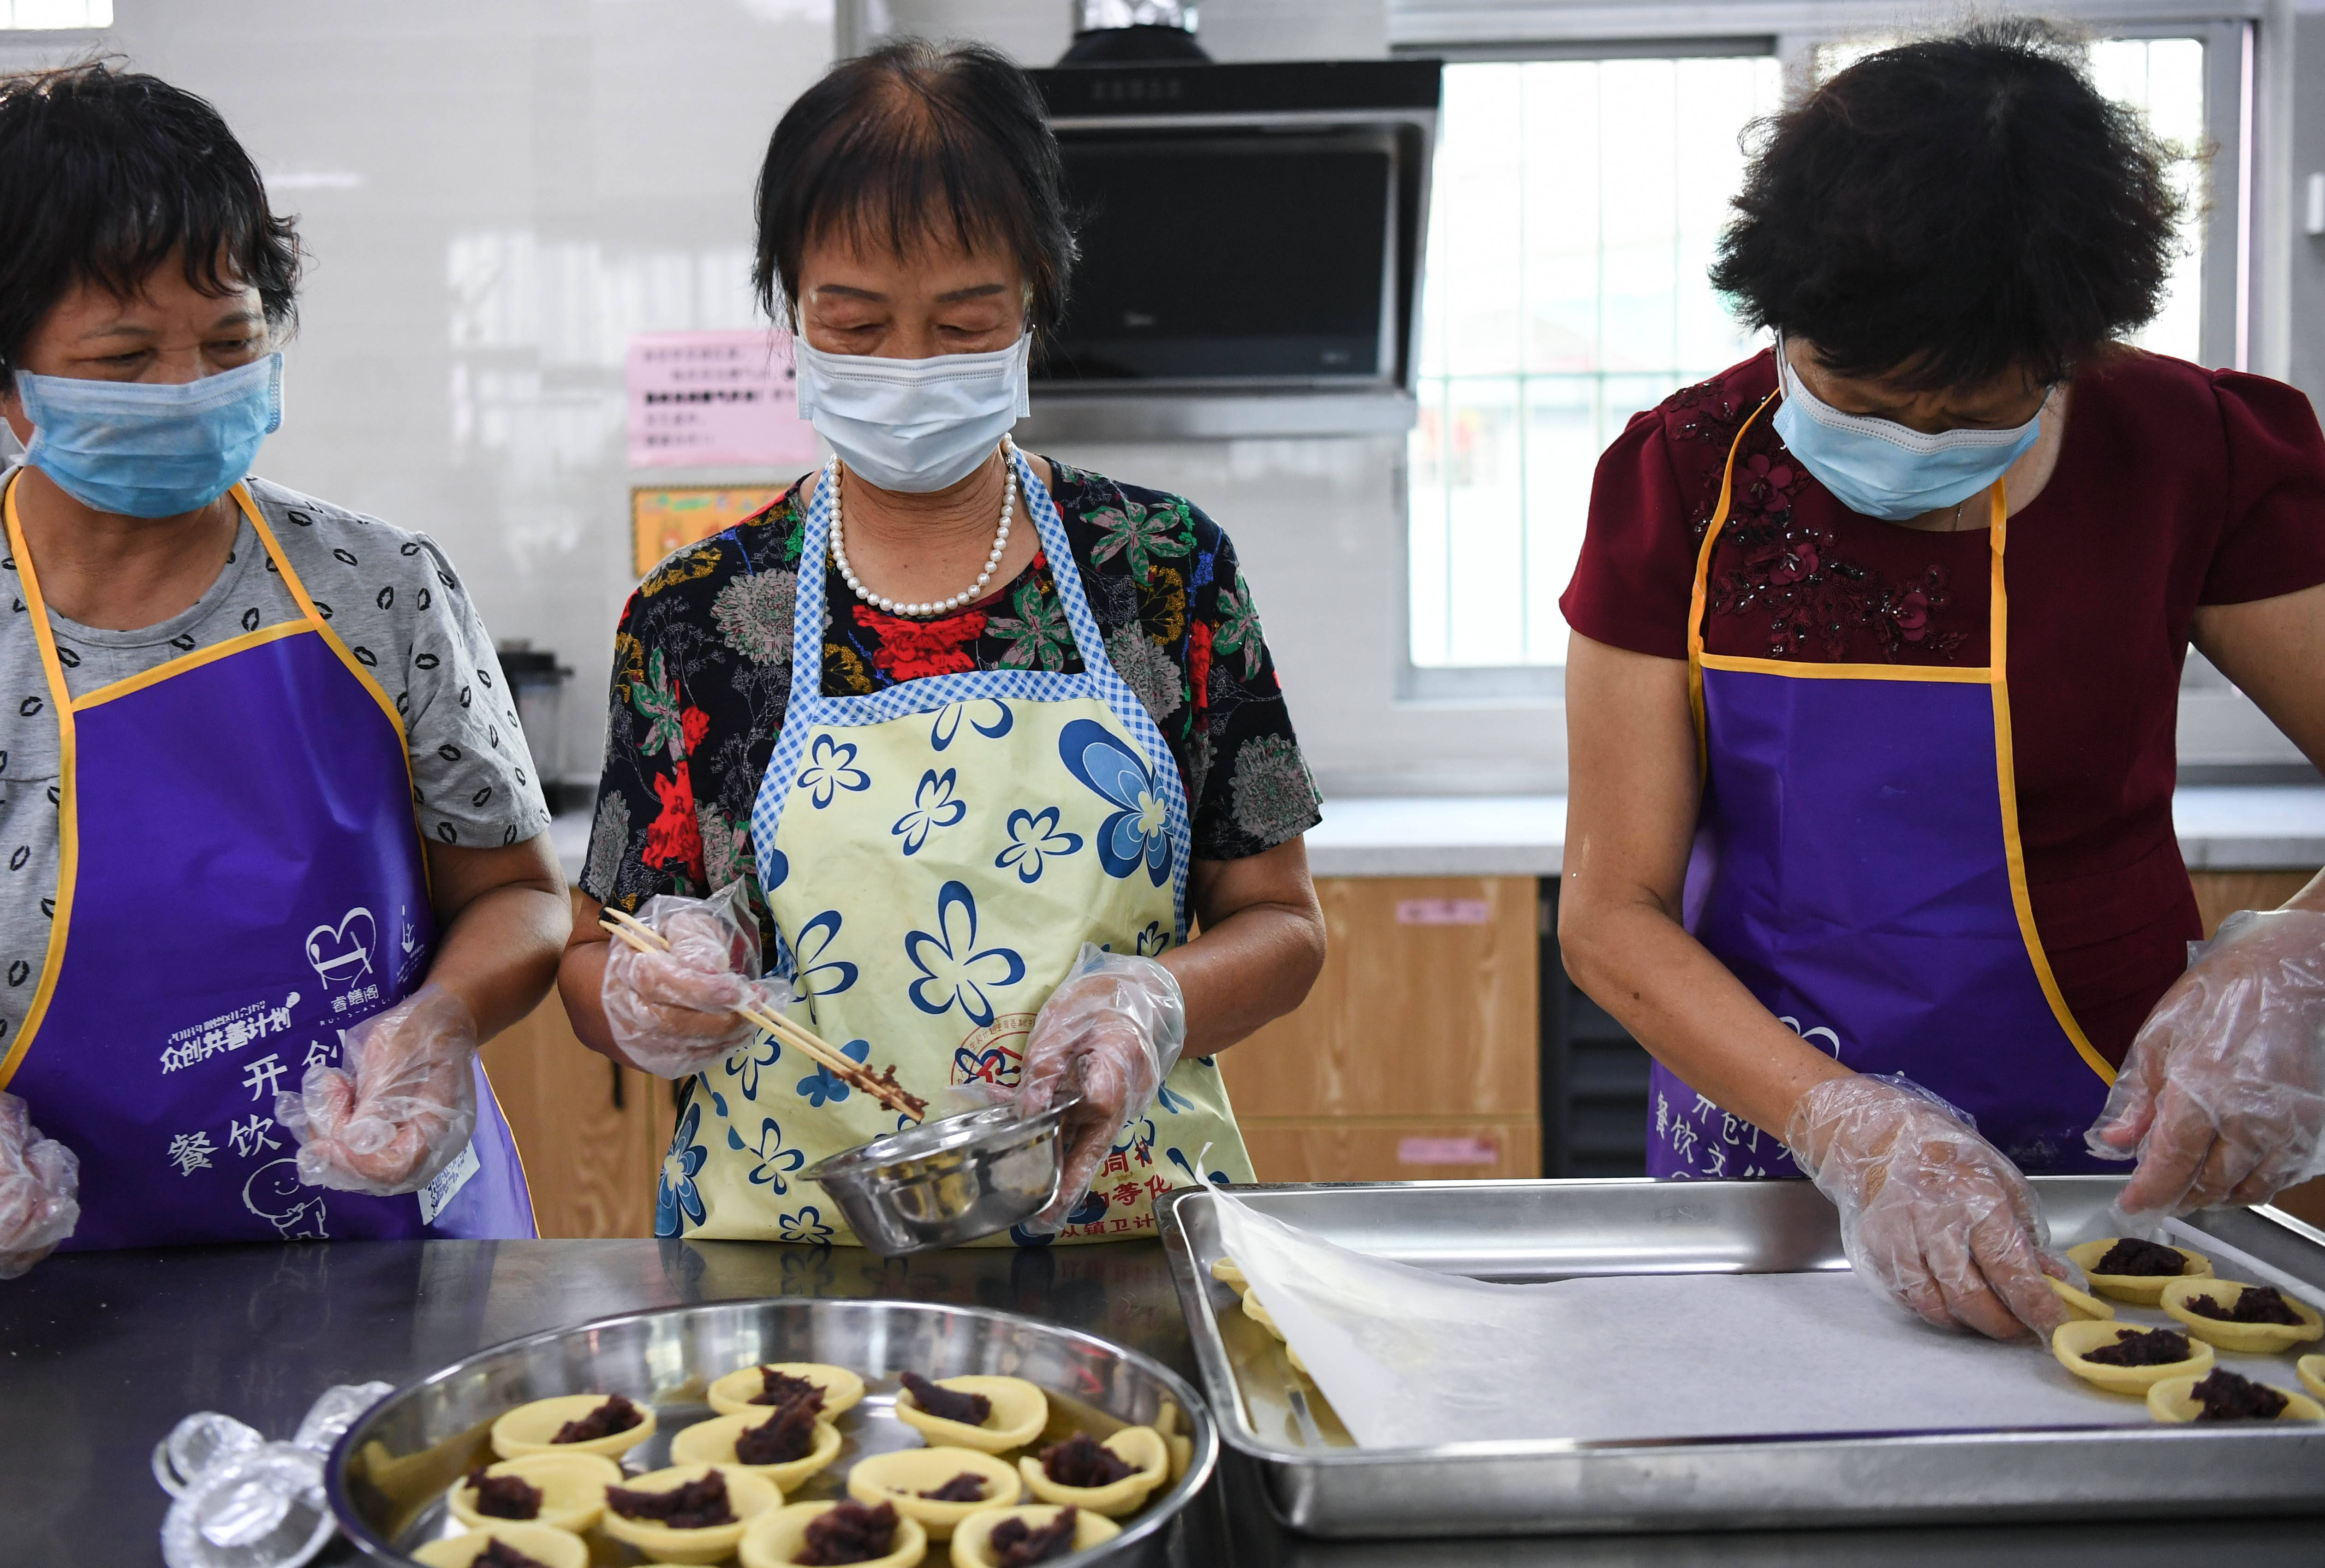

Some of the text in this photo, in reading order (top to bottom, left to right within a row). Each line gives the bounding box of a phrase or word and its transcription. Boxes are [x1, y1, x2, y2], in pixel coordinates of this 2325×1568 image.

[160, 1007, 292, 1075] 众创共善计划
[167, 1114, 282, 1177] 餐饮
